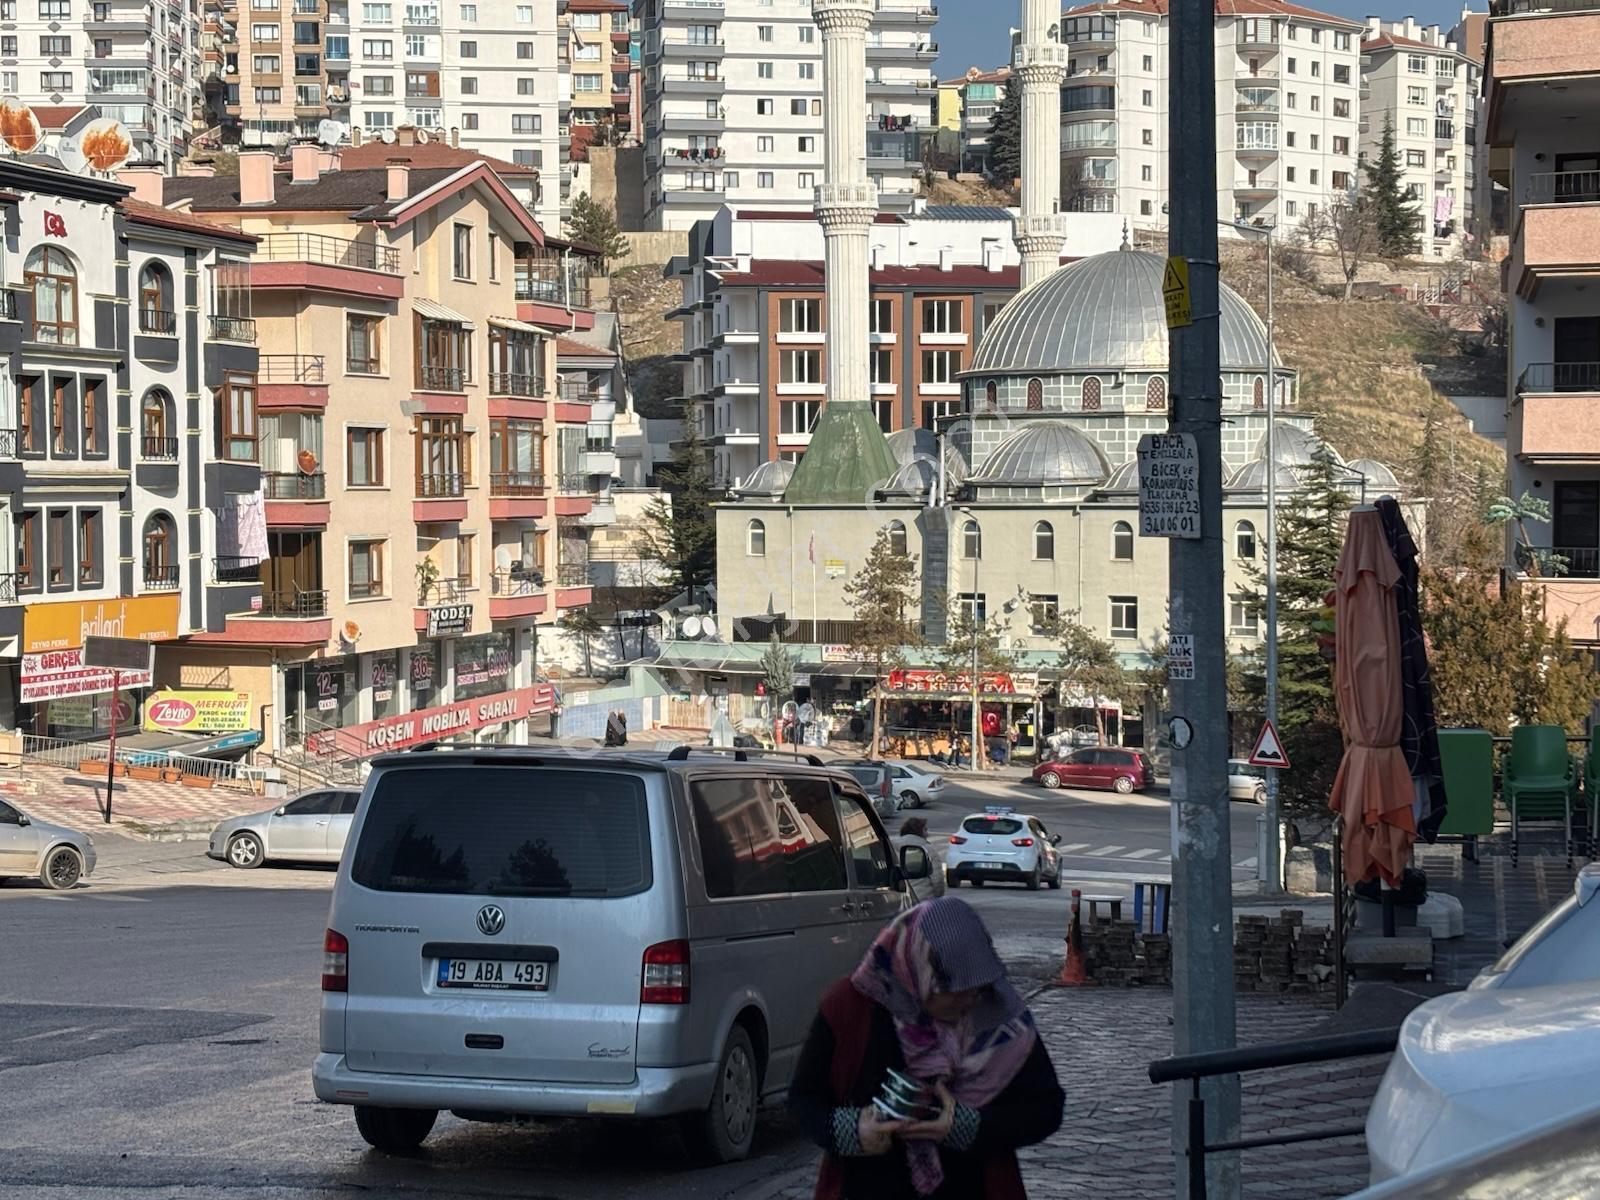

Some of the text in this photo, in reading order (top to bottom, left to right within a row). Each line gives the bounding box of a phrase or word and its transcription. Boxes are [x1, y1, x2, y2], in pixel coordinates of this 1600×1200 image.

[1152, 435, 1184, 449] BACA
[431, 606, 472, 621] MODEL
[41, 651, 81, 670] GERÇEK
[317, 672, 331, 696] 12
[155, 704, 191, 721] Zeyno
[367, 698, 518, 749] KÖŞEM MOBİLYA SARAYI
[450, 962, 544, 982] 19 ABA 493
